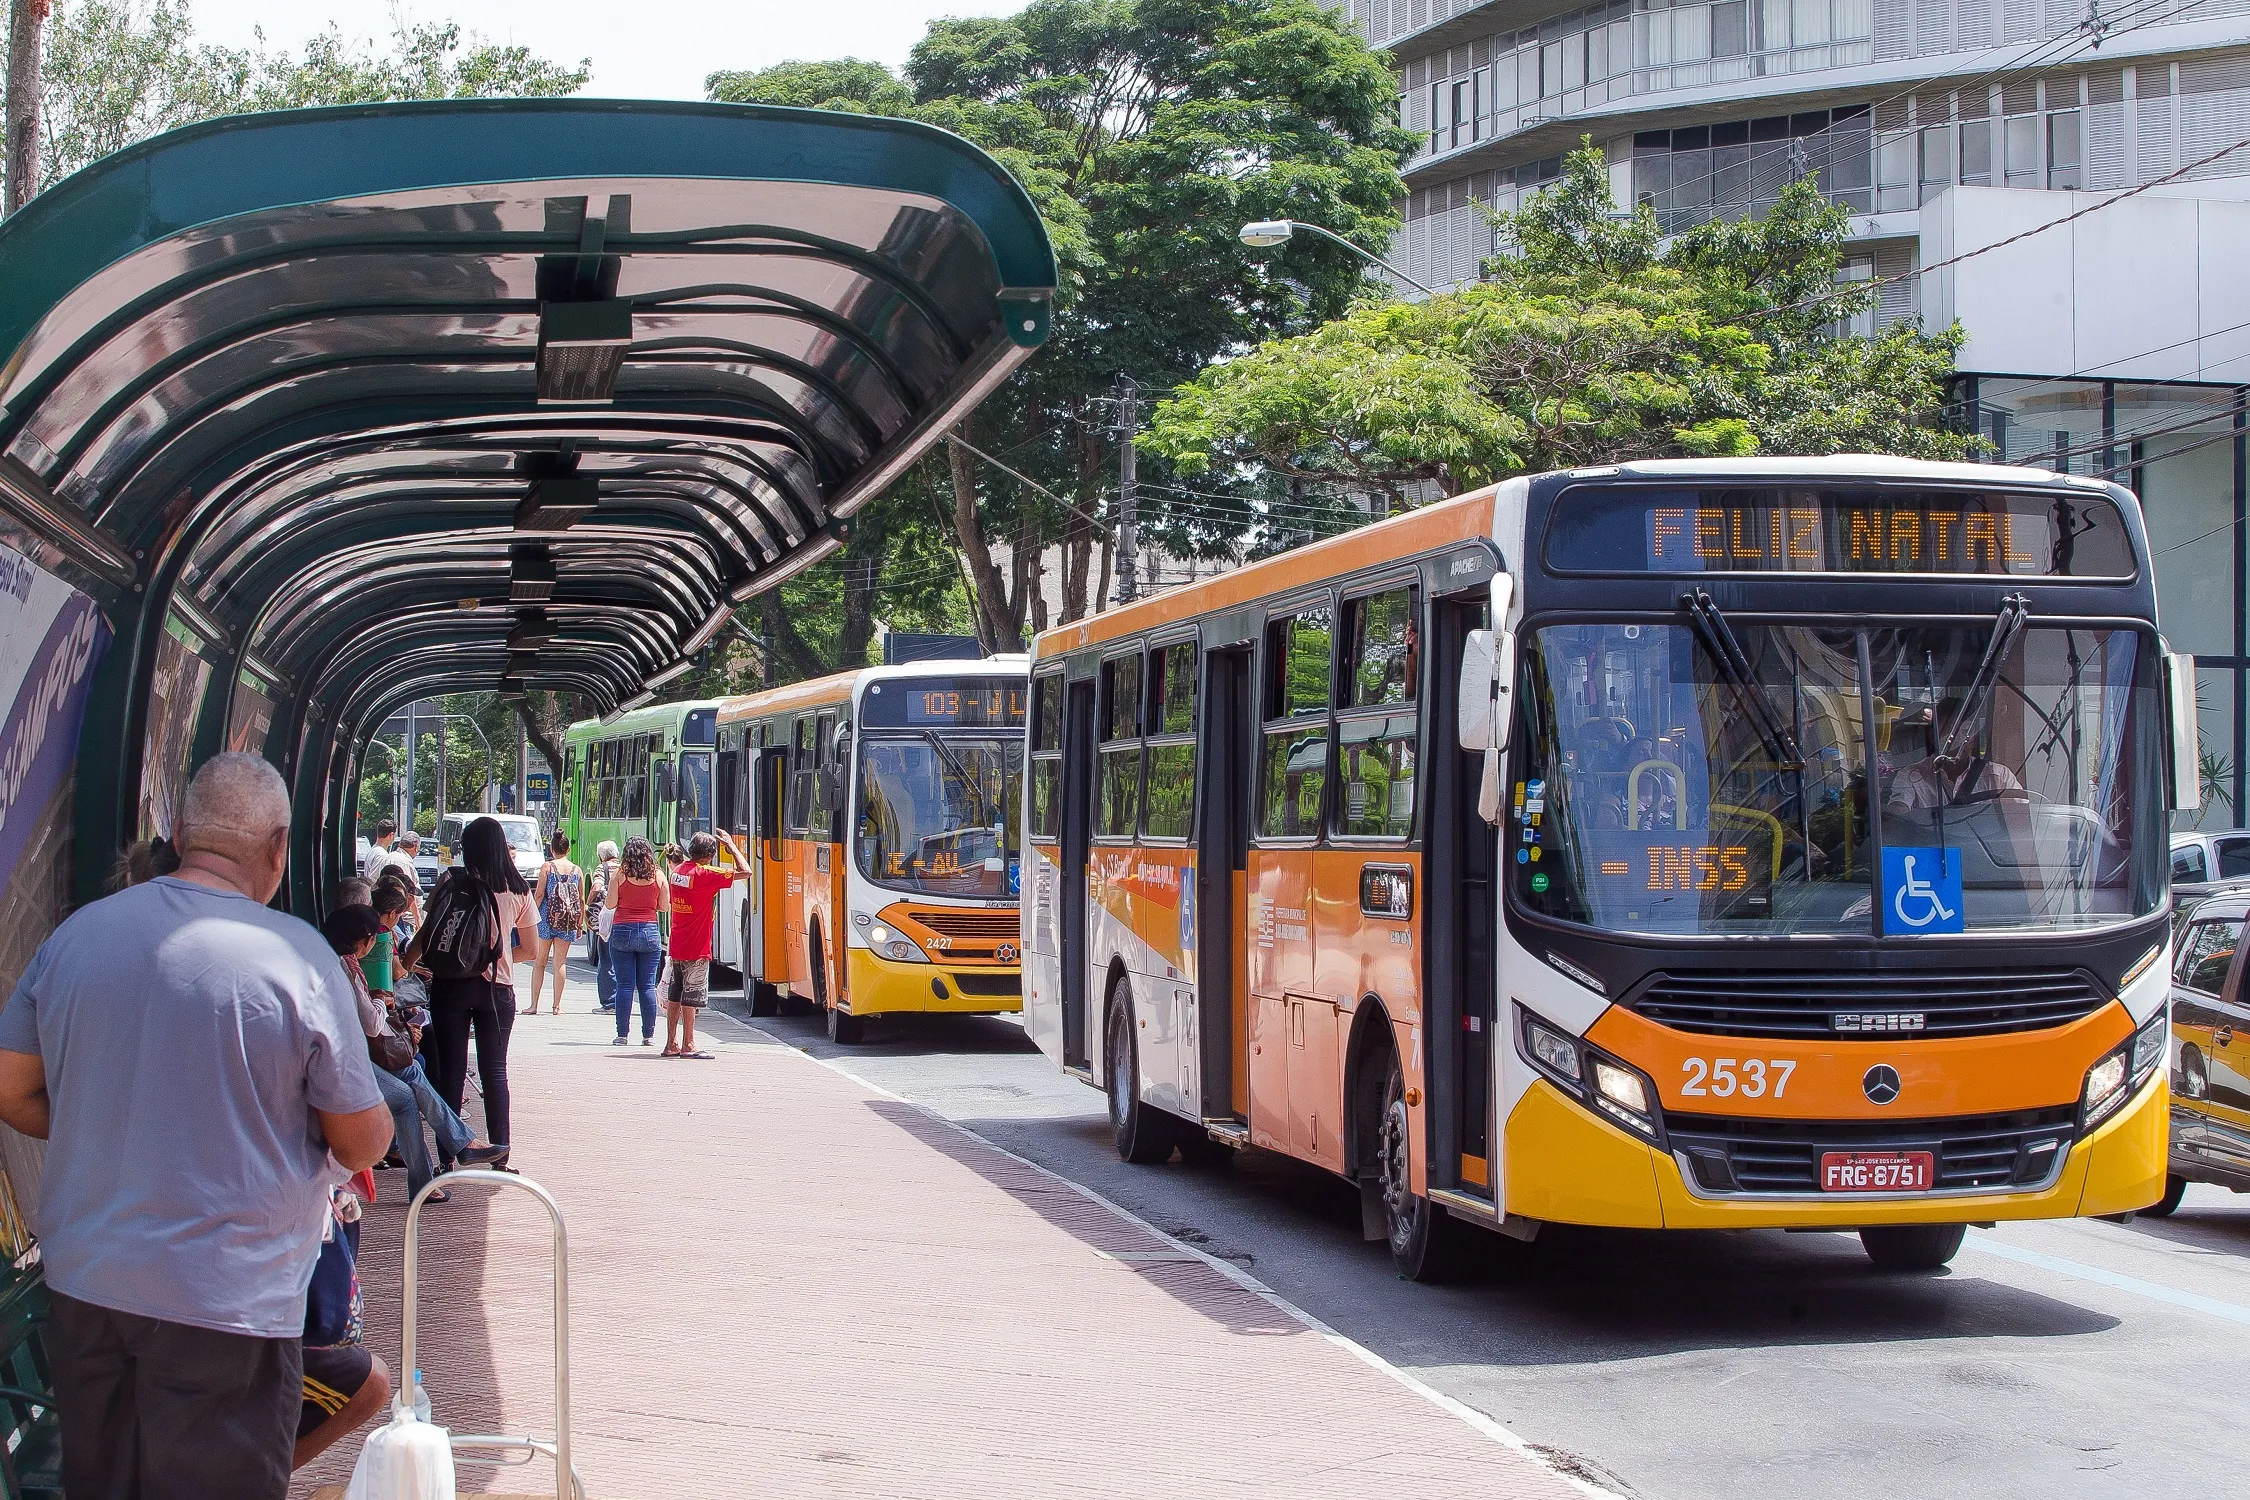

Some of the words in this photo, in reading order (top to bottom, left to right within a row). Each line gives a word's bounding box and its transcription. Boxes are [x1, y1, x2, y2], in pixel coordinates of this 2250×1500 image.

[1654, 508, 1818, 558] FELIZ
[1851, 511, 2033, 561] NATAL
[922, 692, 959, 715] 103
[1011, 692, 1028, 715] L
[527, 779, 549, 789] UES
[1647, 847, 1747, 890] INSS
[926, 938, 953, 949] 2427
[1835, 1014, 1924, 1031] CAIO
[1681, 1057, 1797, 1098] 2537
